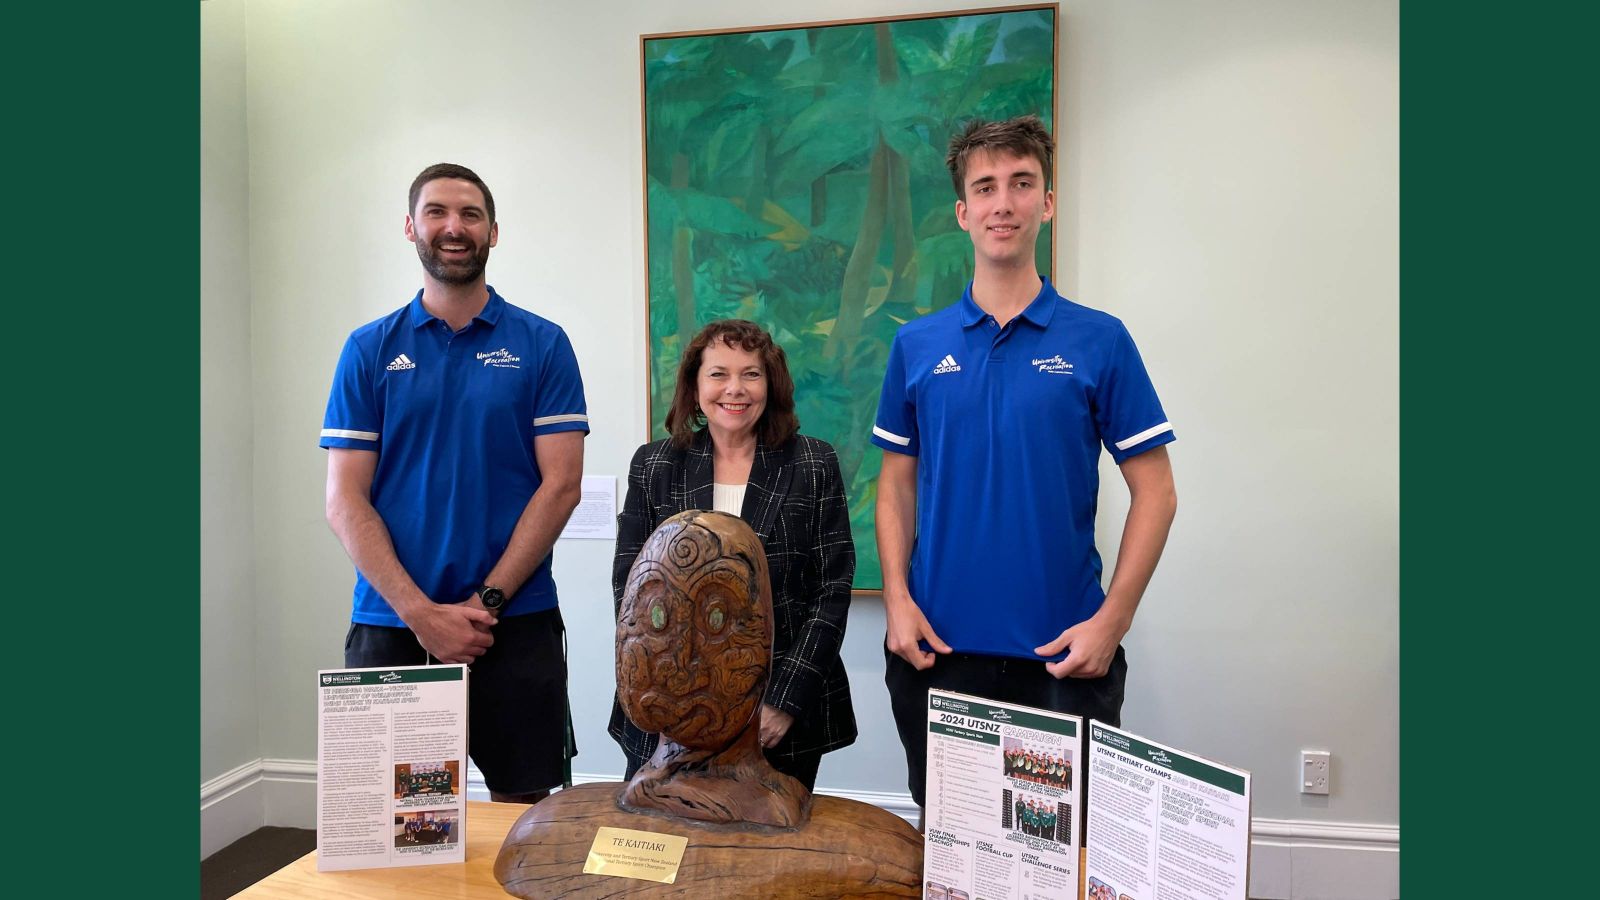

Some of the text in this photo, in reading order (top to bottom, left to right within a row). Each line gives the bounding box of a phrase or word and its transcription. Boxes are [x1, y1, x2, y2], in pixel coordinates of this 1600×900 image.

[476, 348, 509, 360] University
[386, 362, 416, 371] adidas
[484, 355, 520, 367] Recreation
[933, 365, 961, 375] adidas
[940, 713, 965, 726] 2024
[967, 719, 1001, 733] UTSNZ
[1002, 725, 1062, 746] CAMPAIGN
[1102, 734, 1130, 747] WELLINGTON
[1096, 746, 1116, 759] UTSNZ
[1116, 754, 1143, 769] TERTIARY
[1144, 765, 1172, 780] CHAMPS
[1115, 765, 1144, 783] HISTORY
[1144, 776, 1155, 786] OF
[929, 827, 957, 839] VUW FINAL
[613, 837, 666, 852] TE KAITIAKI
[928, 832, 970, 847] CHAMPIONSHIPS
[928, 838, 953, 848] PLACINGS
[976, 840, 994, 849] UTSNZ
[976, 845, 1014, 859] FOOTBALL CUP
[1021, 852, 1040, 861] UTSNZ
[1021, 857, 1071, 875] CHALLENGE SERIES
